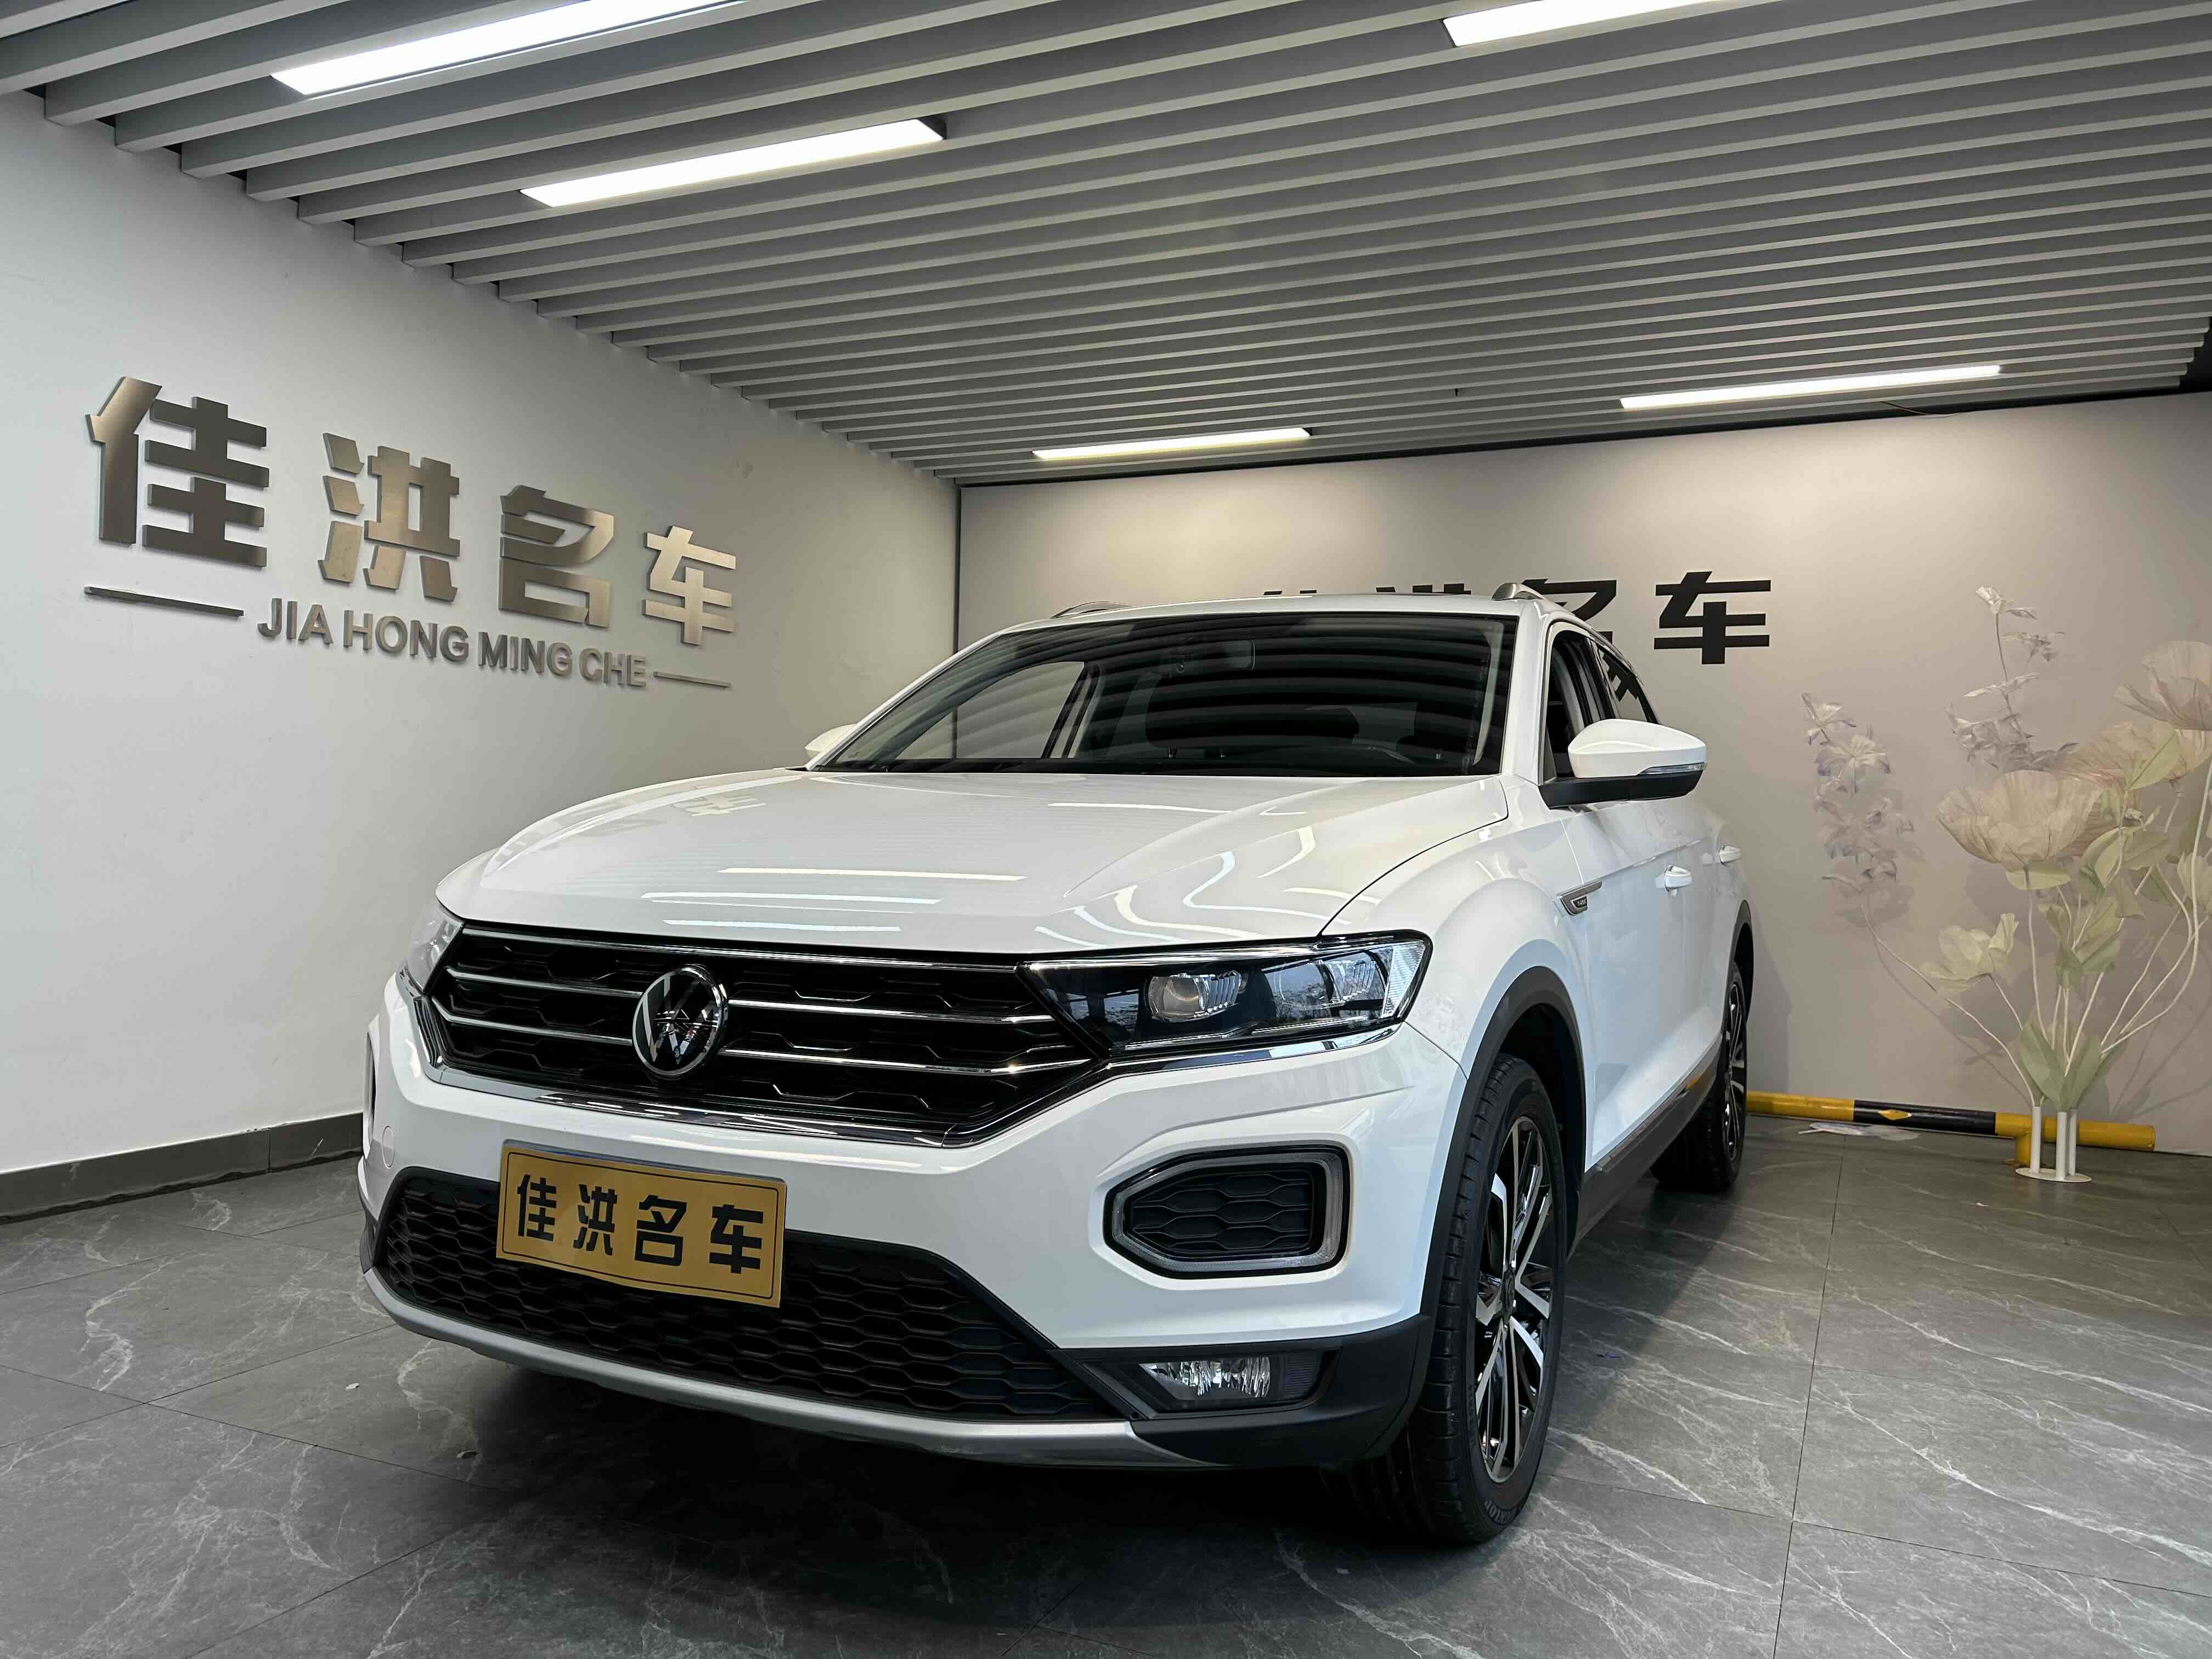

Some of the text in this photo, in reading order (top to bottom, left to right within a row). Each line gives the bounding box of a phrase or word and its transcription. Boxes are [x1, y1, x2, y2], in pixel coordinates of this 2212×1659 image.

[86, 377, 736, 645] 佳洪名车
[257, 597, 646, 687] JIA HONG MING CHE
[517, 1174, 764, 1274] 佳洪名车
